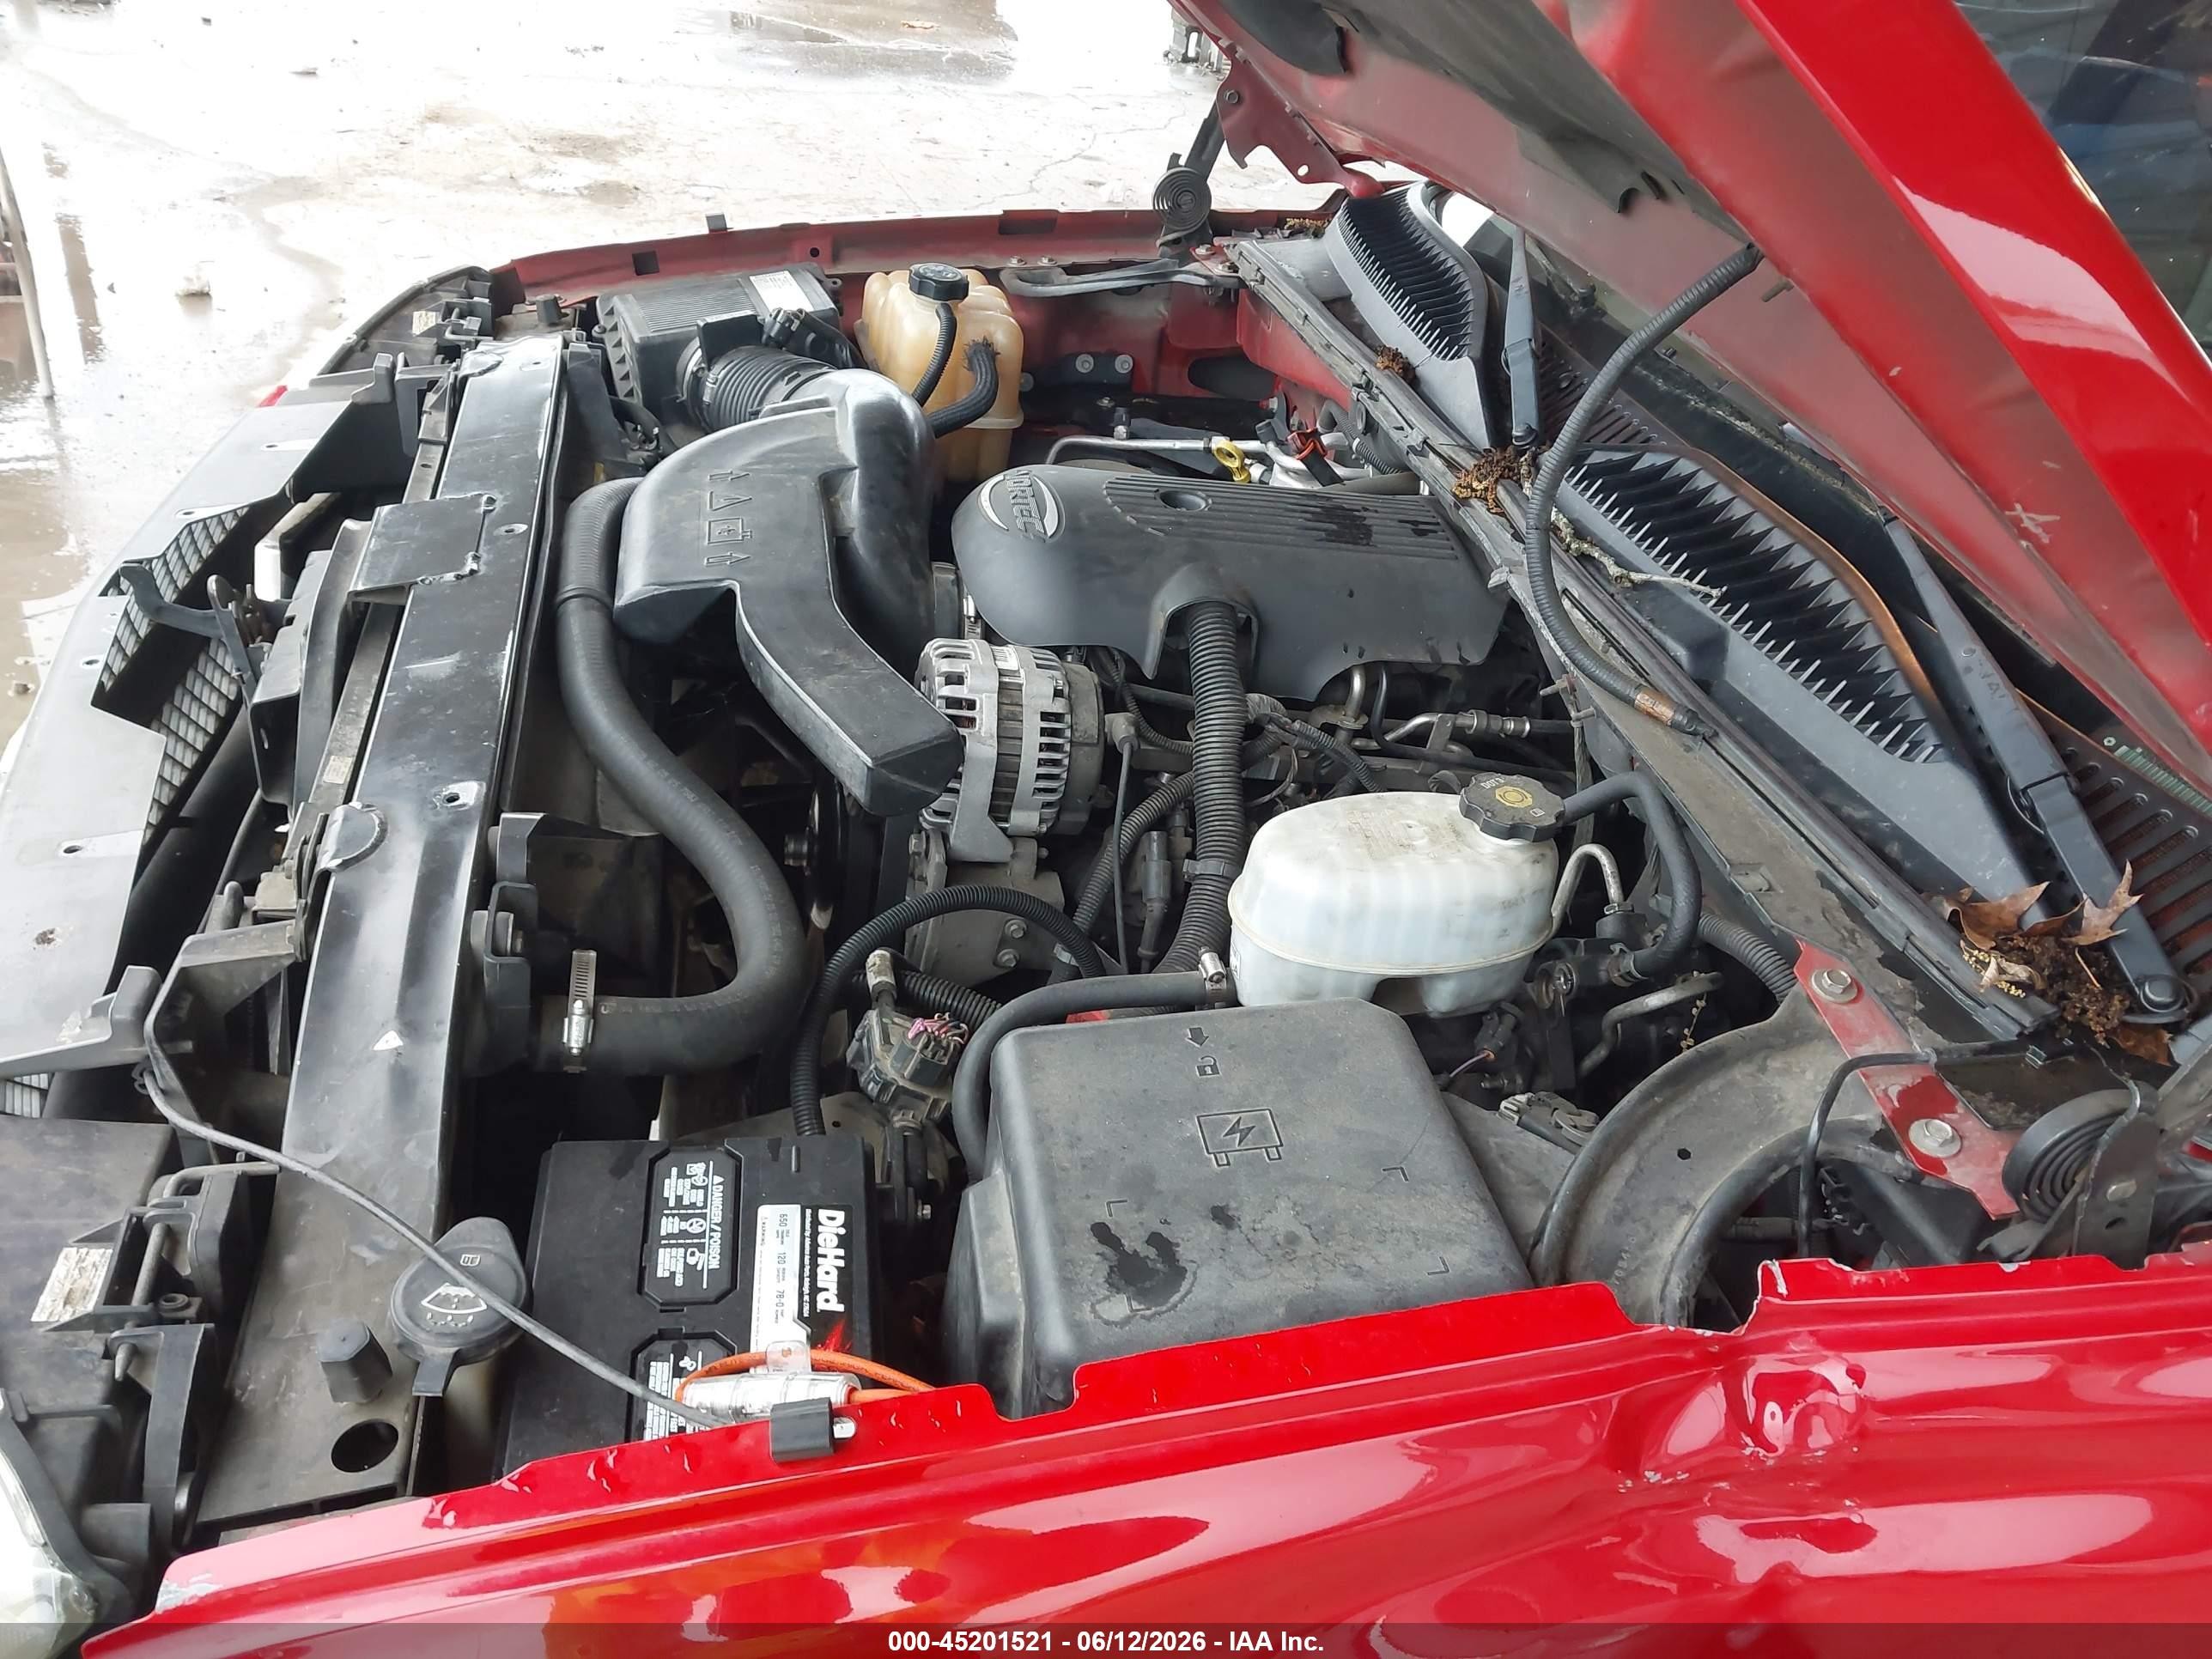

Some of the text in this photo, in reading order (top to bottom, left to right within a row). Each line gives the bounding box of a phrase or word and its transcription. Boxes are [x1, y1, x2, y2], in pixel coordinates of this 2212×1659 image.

[1480, 779, 1499, 789] DOT
[710, 1185, 724, 1223] DANGER
[779, 1213, 788, 1227] 650
[708, 1232, 721, 1269] POISON
[777, 1252, 787, 1265] 120
[817, 1208, 847, 1312] DieHard
